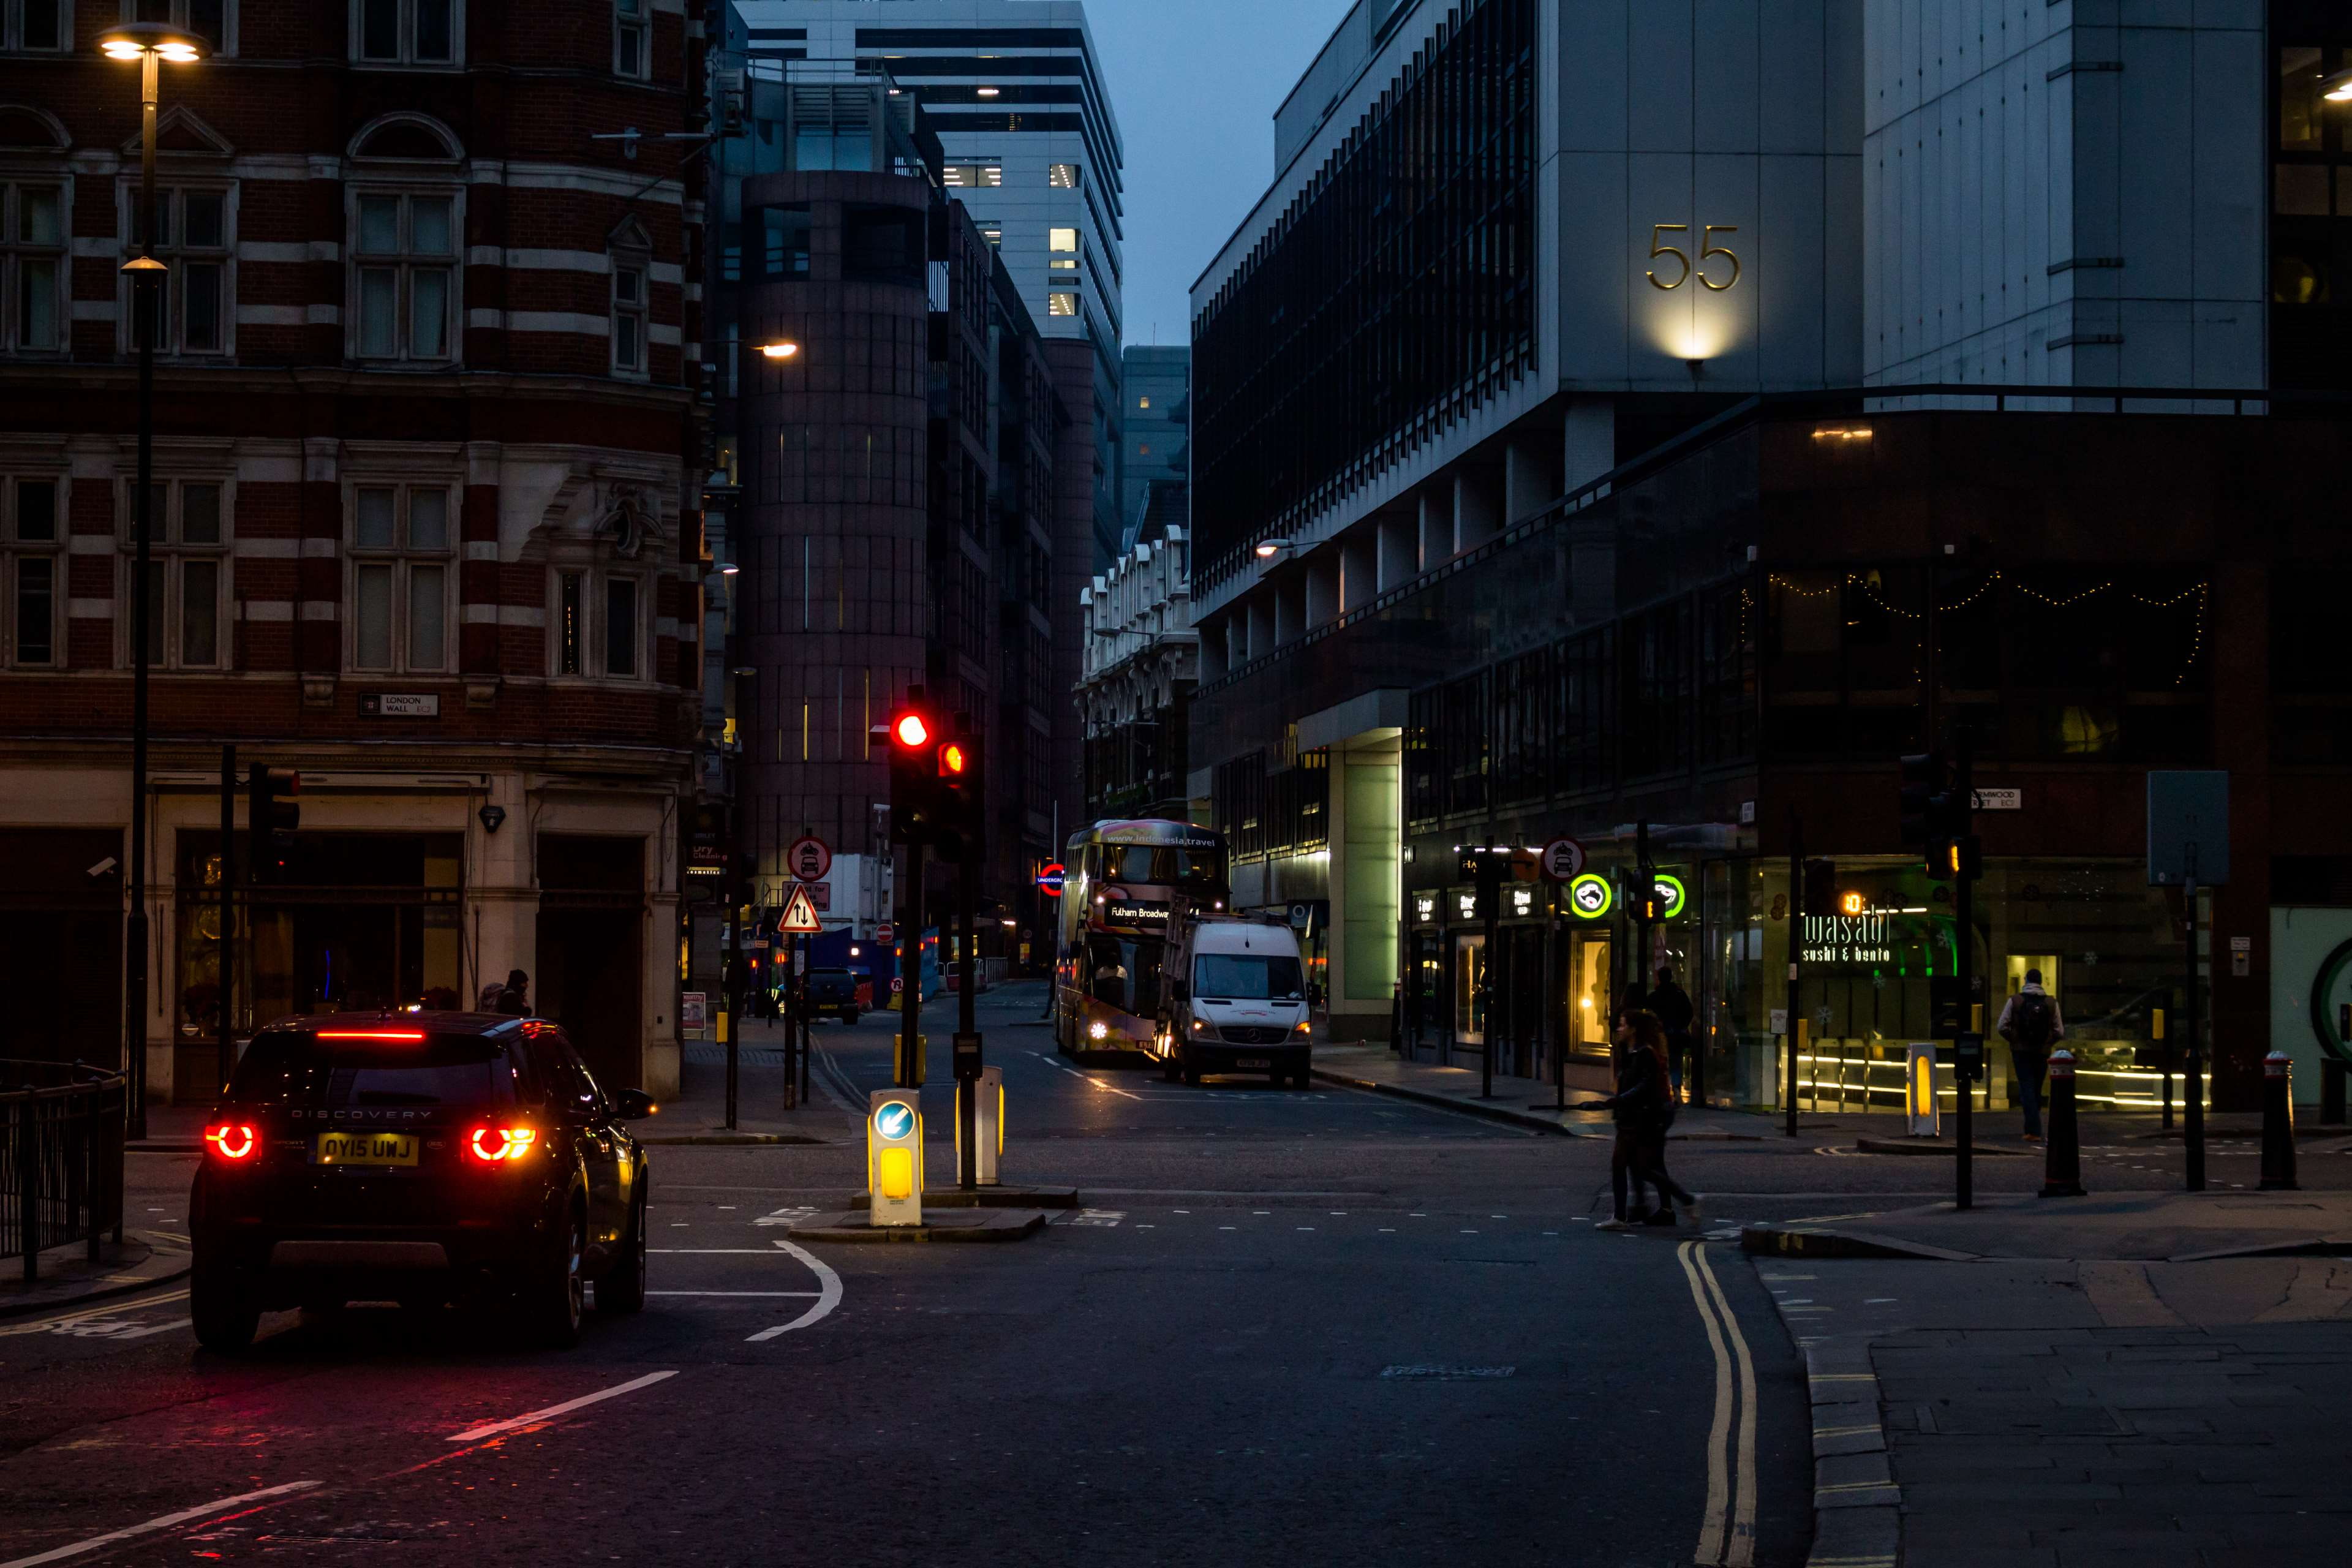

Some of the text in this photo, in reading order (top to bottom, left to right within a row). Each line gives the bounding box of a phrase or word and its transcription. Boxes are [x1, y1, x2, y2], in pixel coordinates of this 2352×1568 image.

[1646, 224, 1742, 292] 55
[1107, 835, 1215, 847] www.indonesia.travel
[1112, 907, 1137, 917] Fulham
[1805, 903, 1890, 944] wasabi
[1803, 946, 1890, 962] sushi & bento
[292, 1109, 432, 1119] DISCOVERY
[326, 1139, 410, 1158] OY15 UWJ
